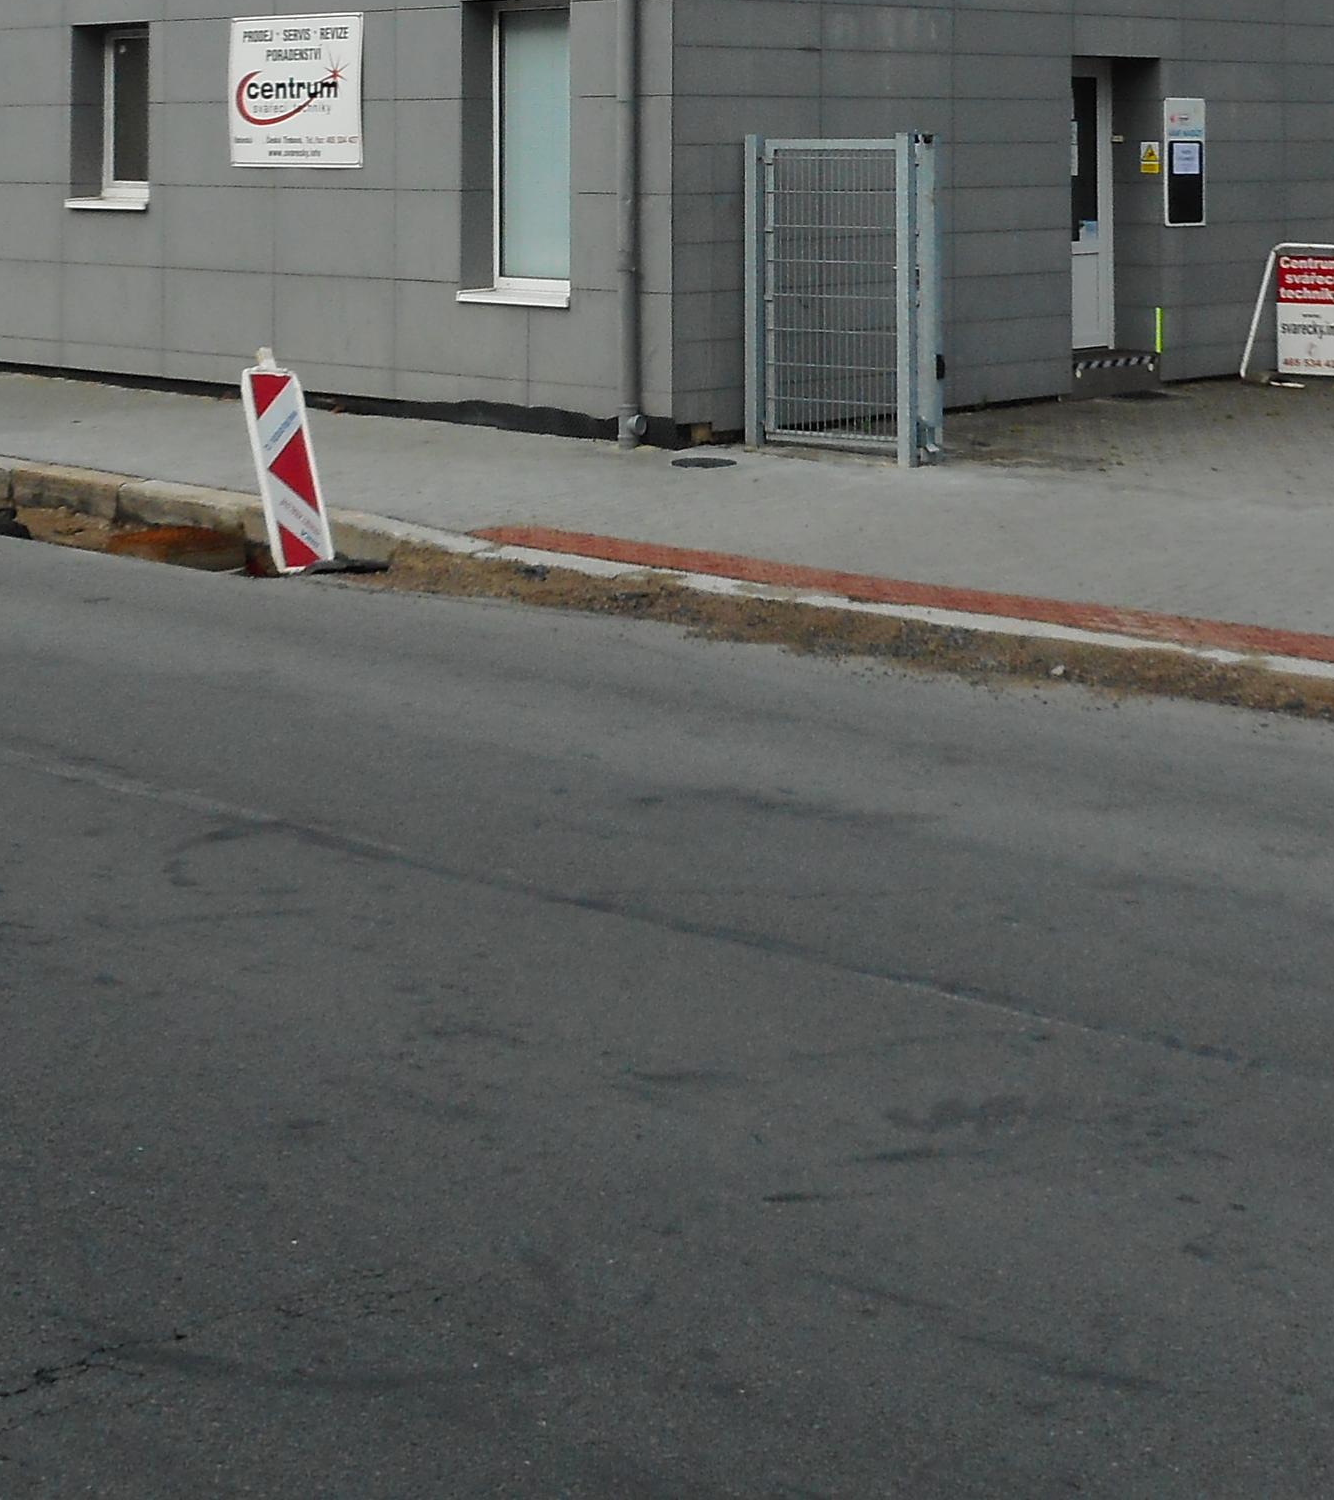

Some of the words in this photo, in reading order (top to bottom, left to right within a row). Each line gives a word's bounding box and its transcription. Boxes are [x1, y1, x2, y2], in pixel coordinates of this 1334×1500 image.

[243, 29, 274, 43] PRODEJ
[282, 27, 311, 42] SERVIS
[319, 26, 350, 40] REVIZE
[246, 77, 339, 100] centrum
